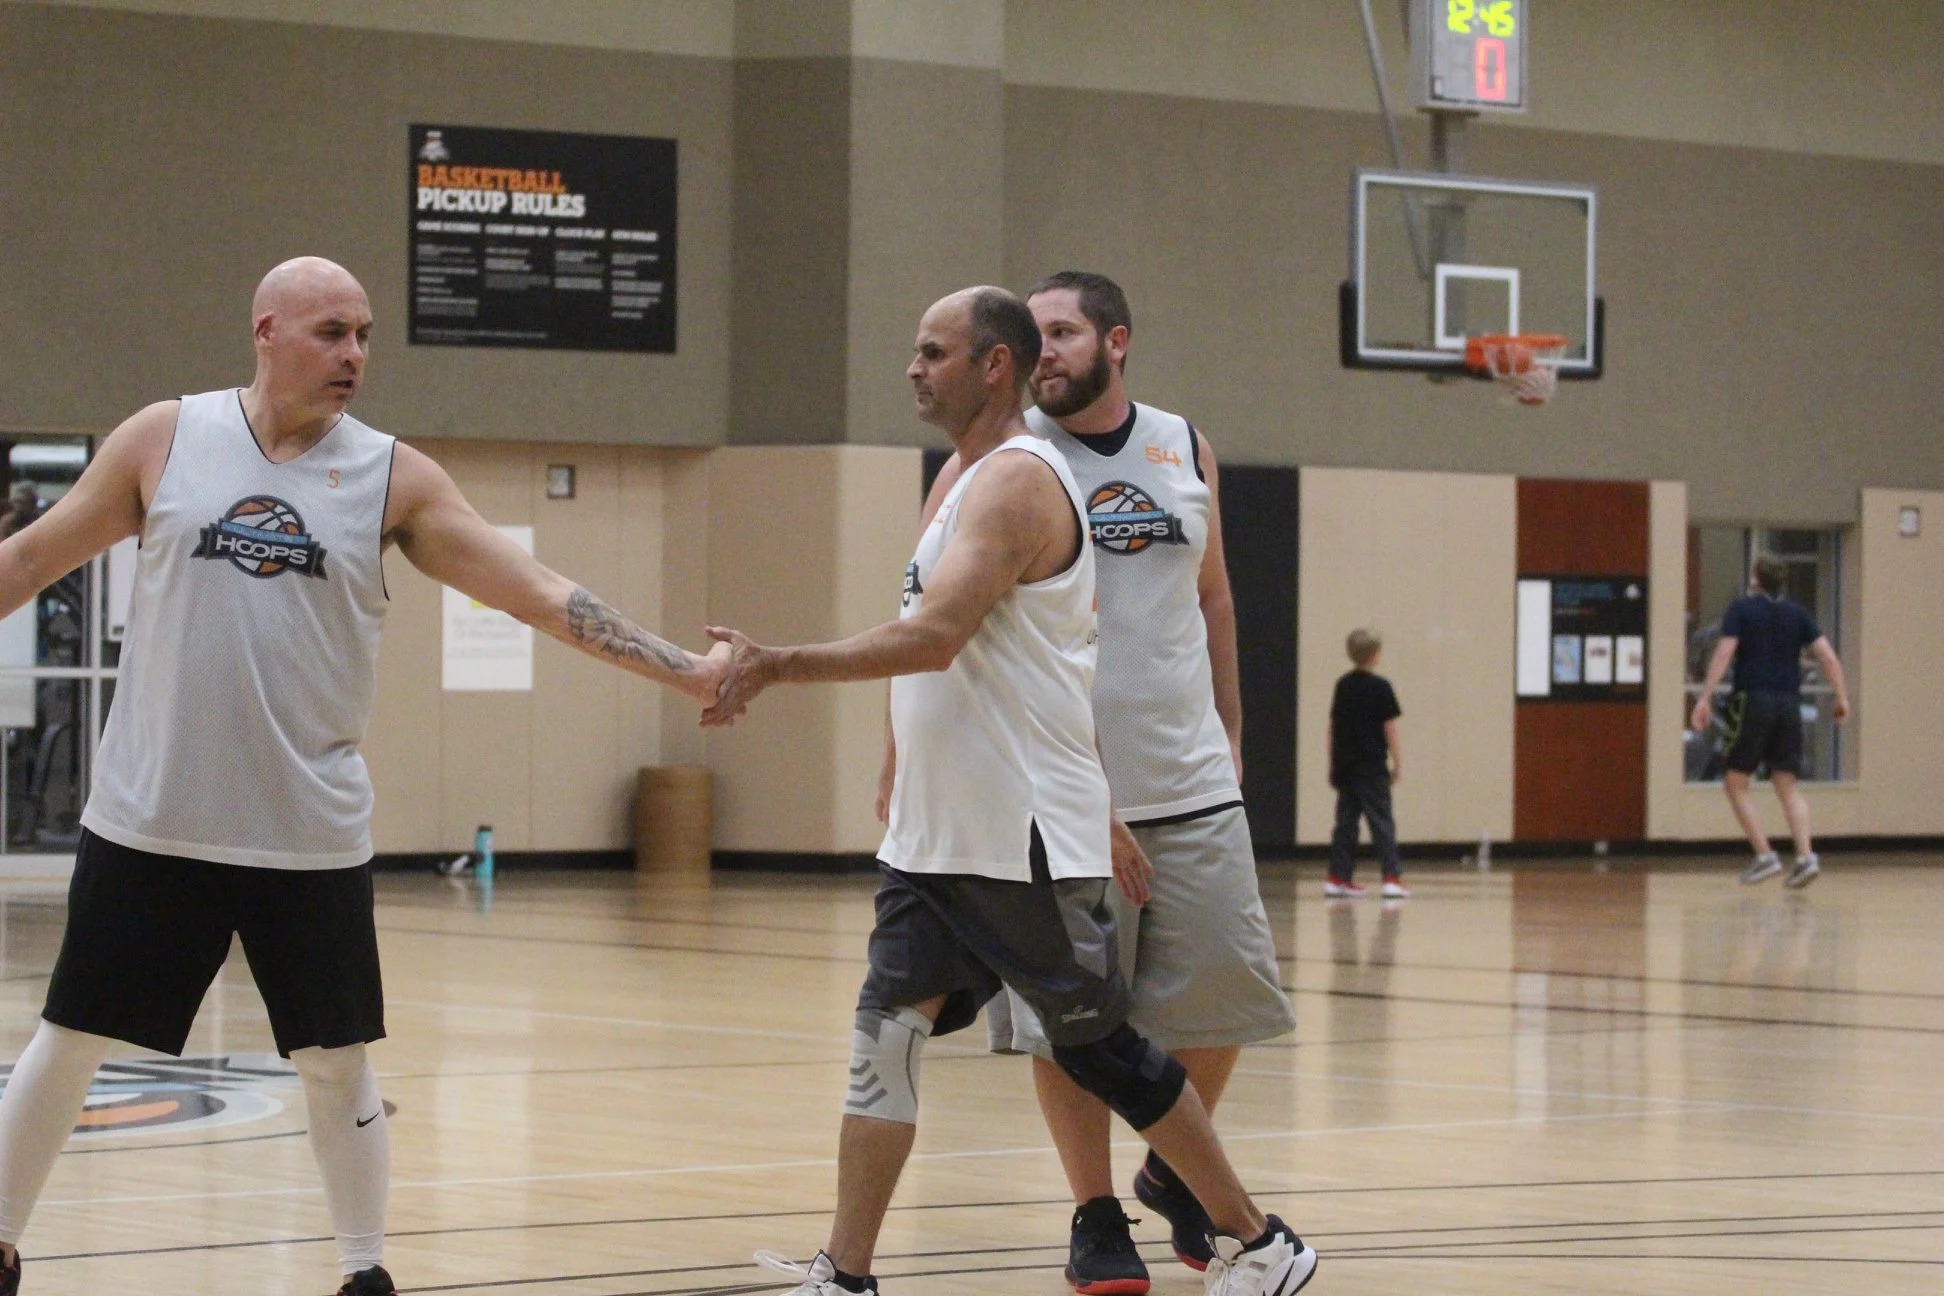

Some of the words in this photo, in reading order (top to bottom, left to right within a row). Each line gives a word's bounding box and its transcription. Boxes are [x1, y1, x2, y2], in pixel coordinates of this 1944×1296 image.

[1476, 38, 1505, 99] 0
[417, 164, 566, 194] BASKETBALL
[417, 188, 508, 214] PICKUP
[511, 192, 587, 218] RULES
[1144, 446, 1182, 468] 54
[326, 468, 341, 489] 5
[215, 534, 308, 565] HOOPS
